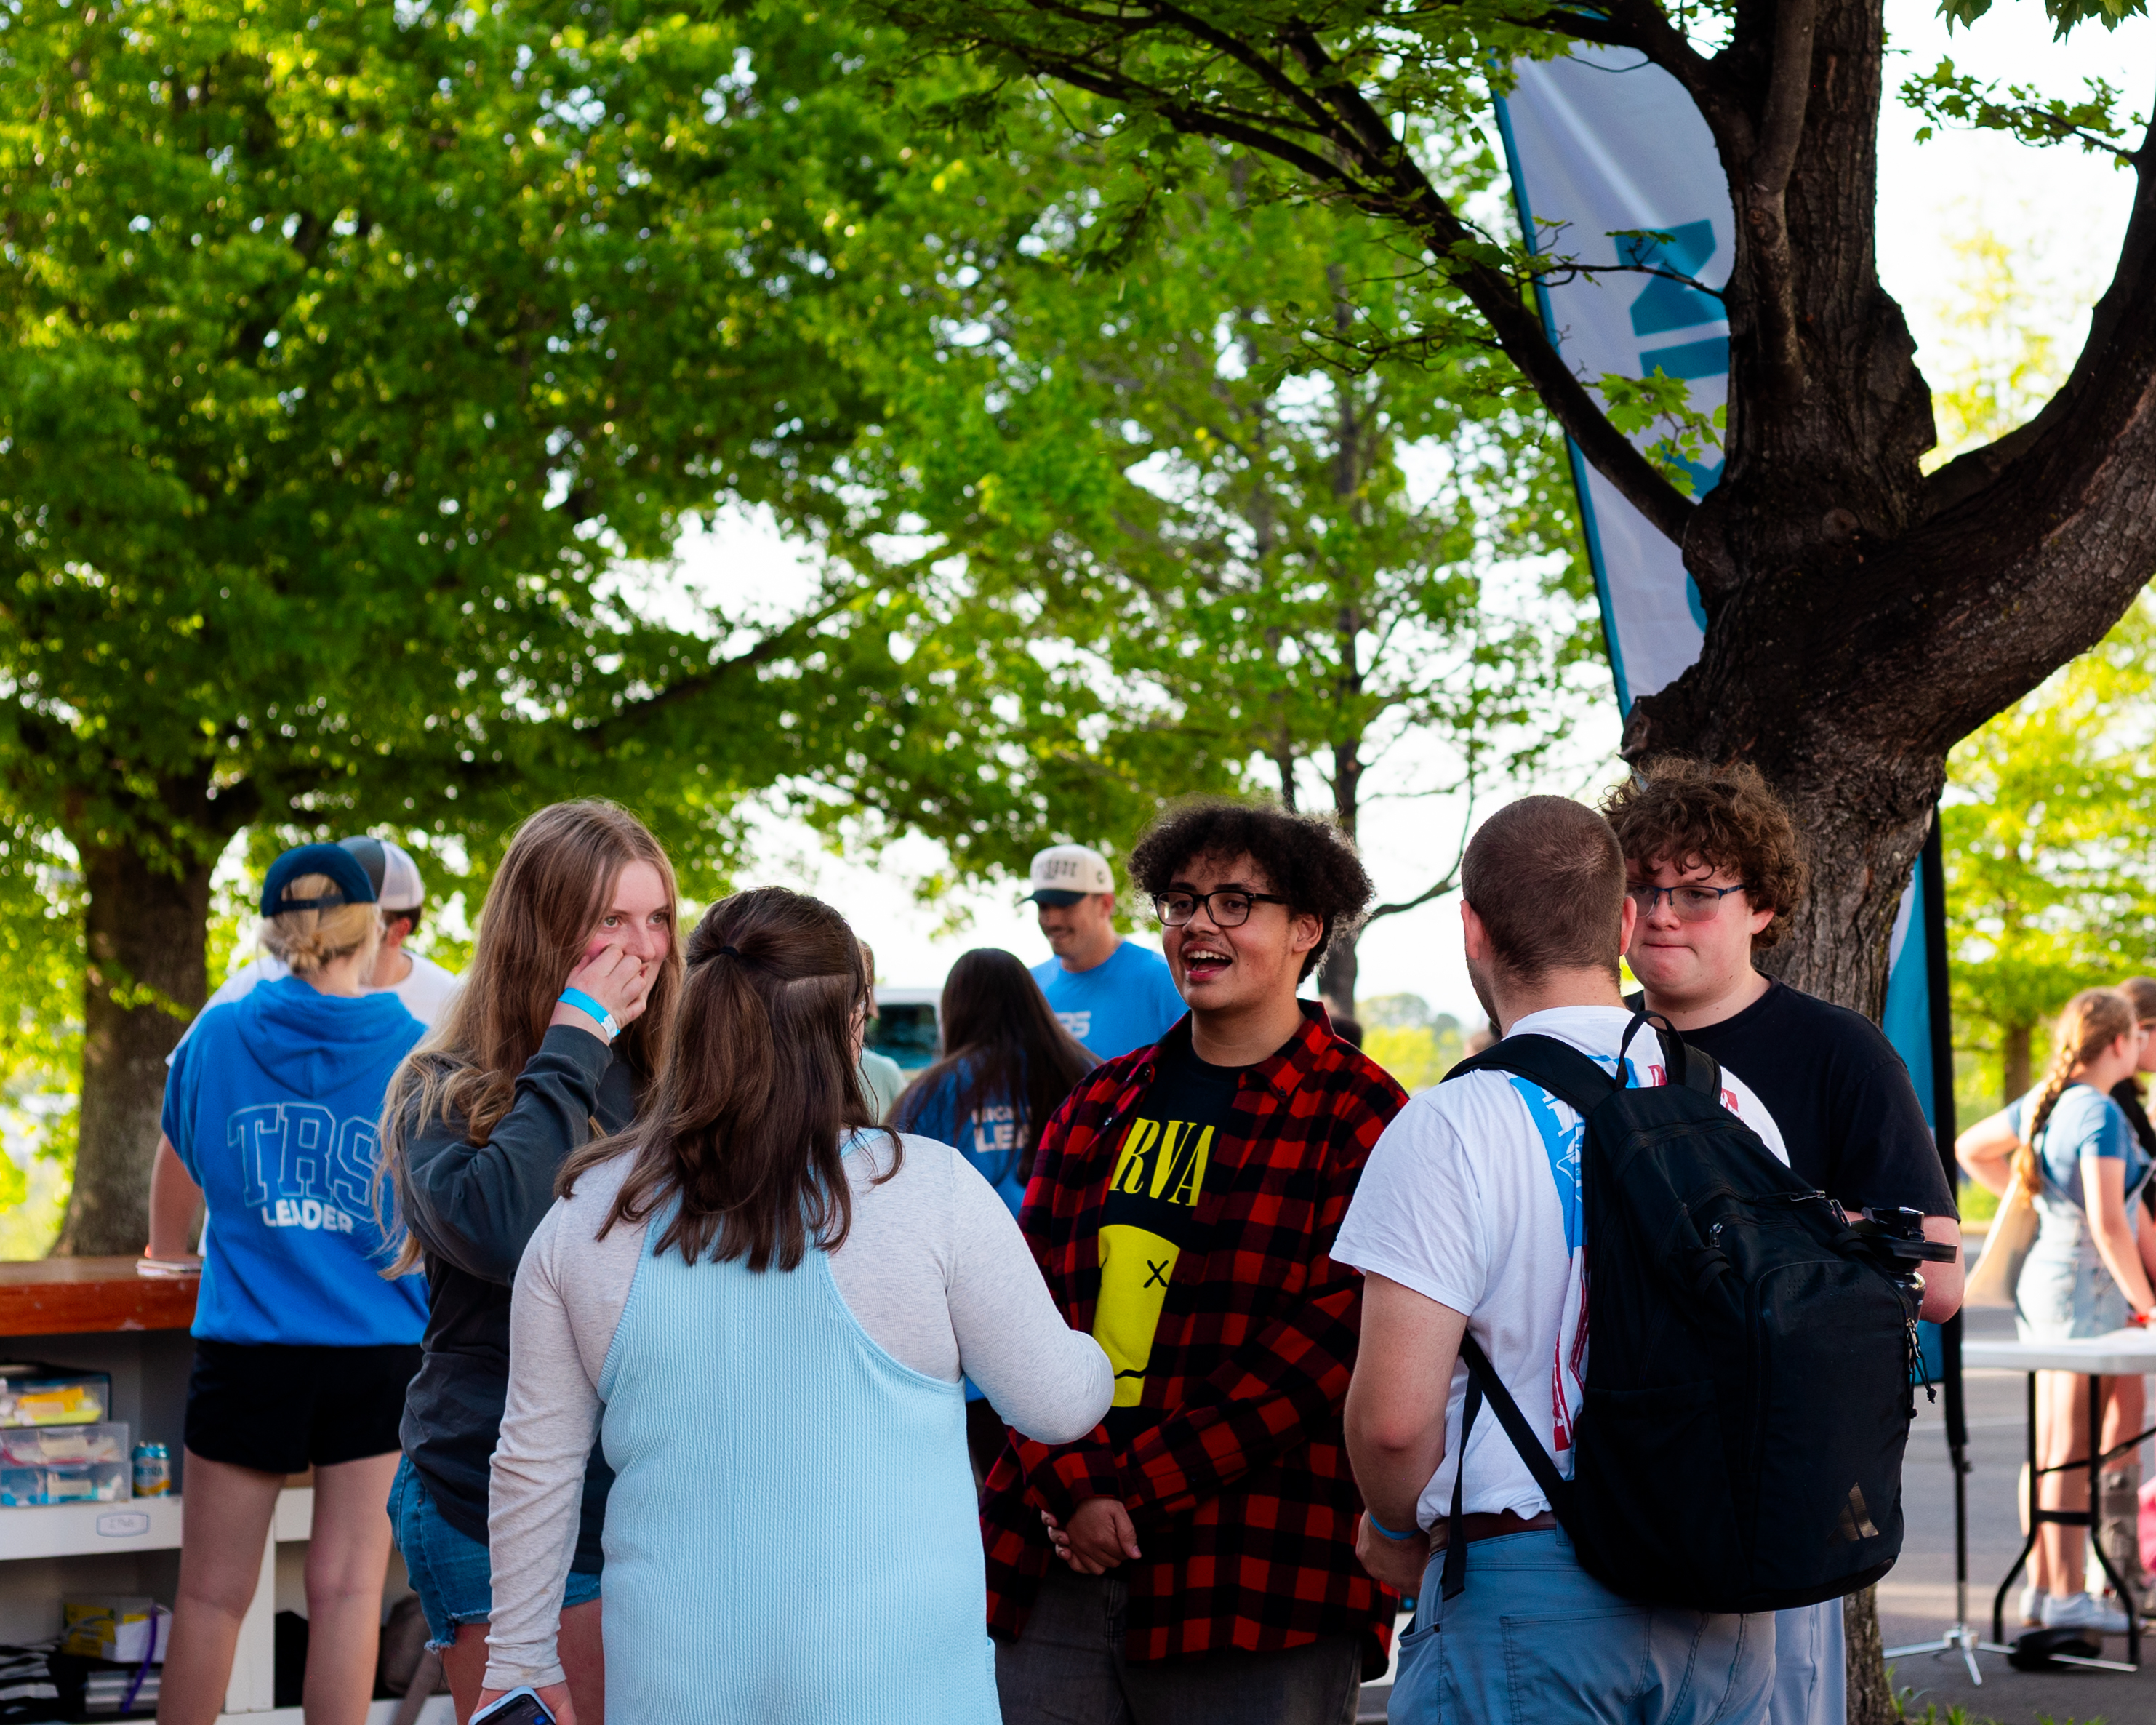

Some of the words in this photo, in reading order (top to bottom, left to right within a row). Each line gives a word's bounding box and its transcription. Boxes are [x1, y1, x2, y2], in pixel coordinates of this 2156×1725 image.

[227, 1101, 385, 1223] TRS
[1108, 1115, 1216, 1207] RVA
[261, 1198, 354, 1235] LEADER
